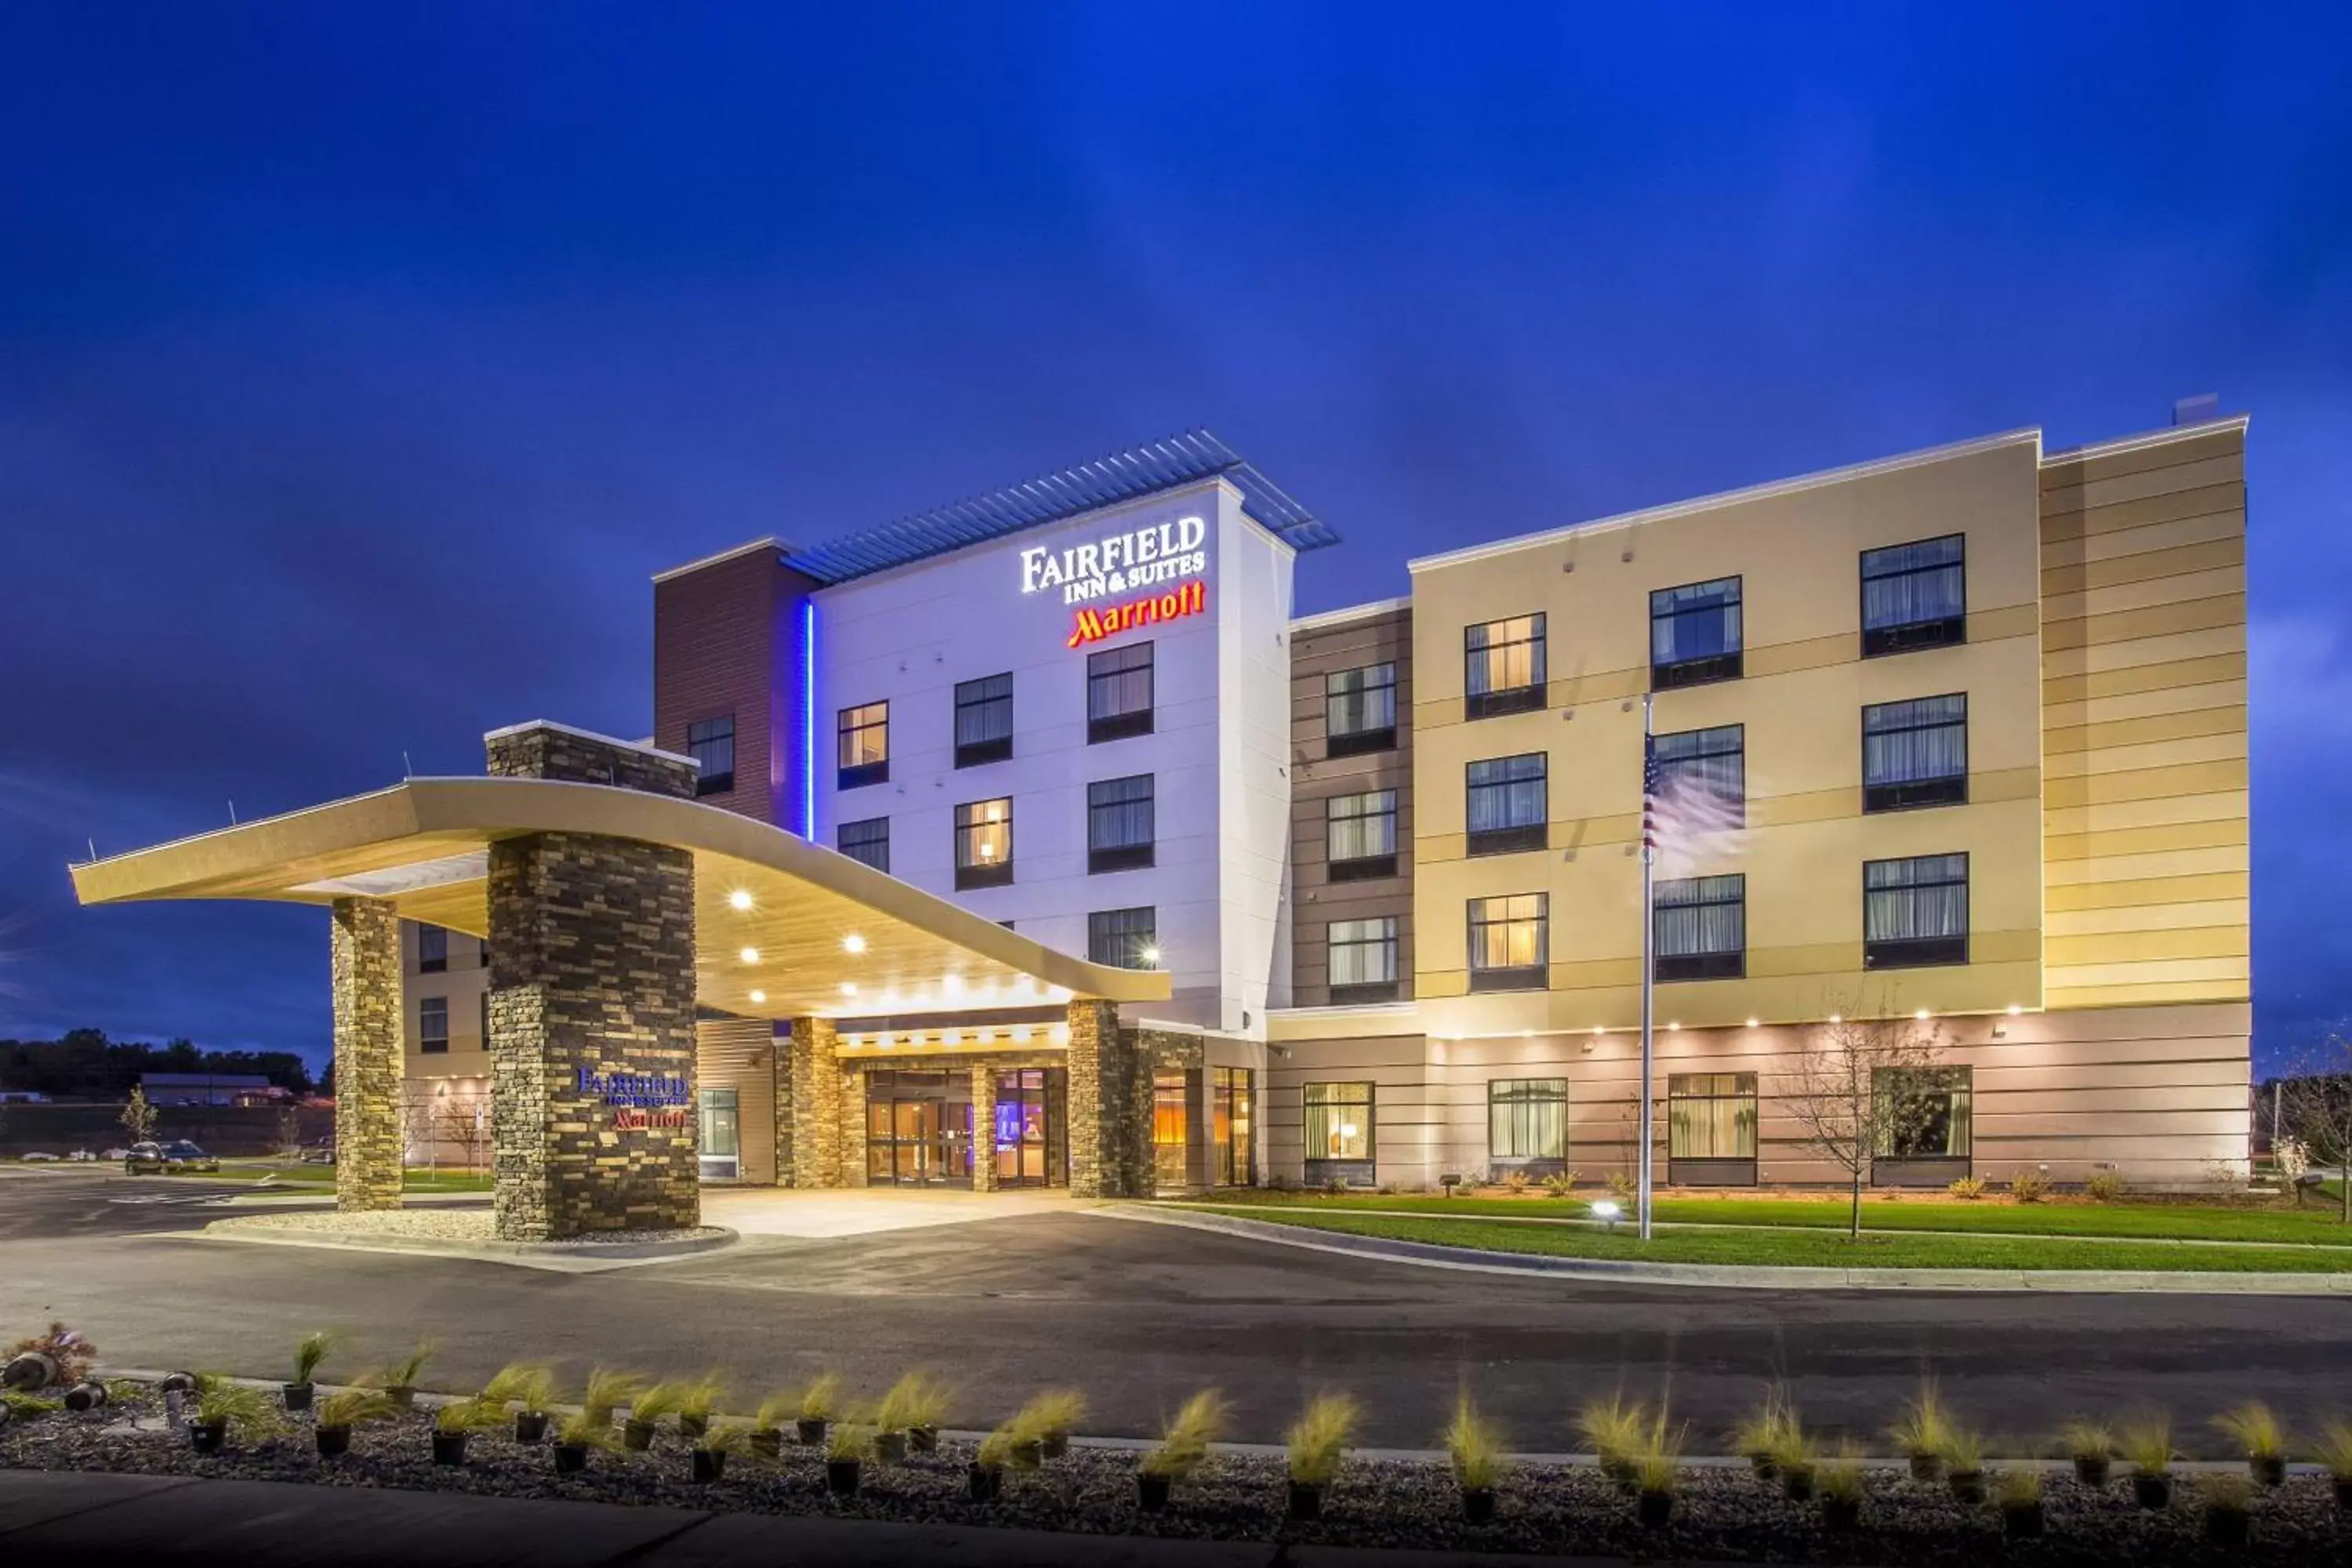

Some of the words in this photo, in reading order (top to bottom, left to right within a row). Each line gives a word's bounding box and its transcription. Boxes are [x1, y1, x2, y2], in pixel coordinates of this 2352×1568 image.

[1020, 517, 1205, 593] FAIRFIELD
[1064, 576, 1106, 604] INN
[1107, 572, 1127, 593] &
[1128, 552, 1205, 589] SUITES
[1068, 581, 1206, 648] Marriott
[579, 1067, 688, 1095] FAIRFIELD
[613, 1110, 688, 1131] Marriott
